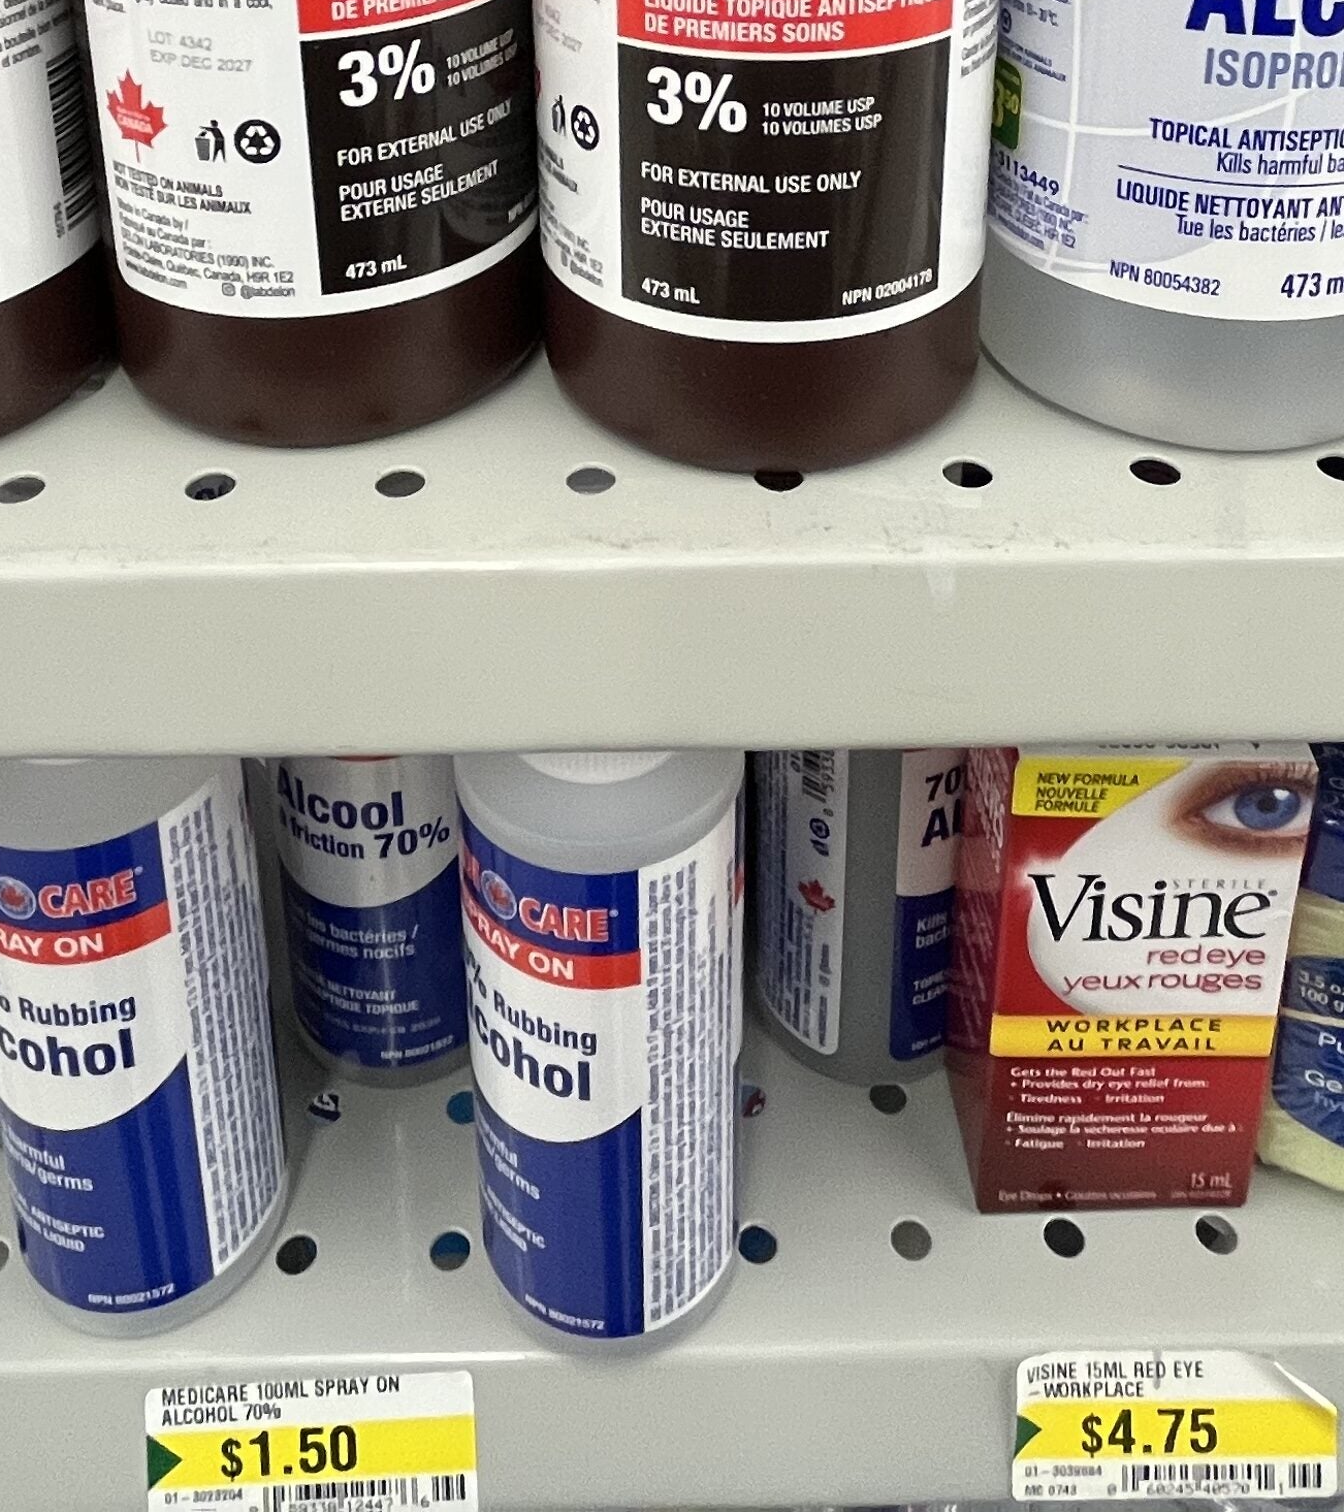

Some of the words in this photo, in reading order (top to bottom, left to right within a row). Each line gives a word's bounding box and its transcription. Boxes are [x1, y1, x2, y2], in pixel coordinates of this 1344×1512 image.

[644, 15, 667, 35] DE
[673, 19, 776, 43] PREMIERS
[782, 21, 845, 43] SOINS
[217, 57, 252, 72] 2027
[336, 40, 435, 108] 3%
[646, 66, 747, 134] 3%
[762, 103, 780, 118] 10
[783, 101, 843, 118] VOLUME
[847, 97, 875, 114] USP
[1149, 116, 1231, 150] TOPICAL
[641, 161, 673, 184] FOR
[679, 169, 770, 194] EXTERNAL
[776, 176, 810, 194] USE
[817, 170, 861, 191] ONLY
[1217, 152, 1252, 174] Kills
[1257, 150, 1324, 176] harmful
[1116, 178, 1190, 213] LIQUIDE
[1194, 192, 1312, 220] NETTOYANT
[1175, 213, 1206, 237] Tue
[1210, 221, 1234, 241] les
[1238, 218, 1316, 242] bactéries
[1109, 261, 1141, 284] NPN
[1144, 269, 1221, 297] 80054382
[1280, 273, 1321, 298] 473
[1036, 787, 1108, 801] NOUVELLE
[1037, 772, 1069, 786] NEW
[1074, 773, 1139, 785] FORMULA
[279, 765, 404, 830] Alcool
[1035, 800, 1101, 813] FORMULE
[375, 816, 450, 858] 70%
[38, 868, 137, 918] CARE
[1028, 874, 1274, 941] Visine
[519, 897, 610, 941] CARE
[53, 934, 104, 958] ON
[1148, 972, 1262, 992] rouges
[20, 996, 137, 1026] Rubbing
[494, 992, 597, 1057] Rubbing
[1047, 1018, 1222, 1033] WORKPLACE
[1048, 1038, 1085, 1050] AU
[1102, 1037, 1216, 1050] TRAVAIL
[1027, 1362, 1077, 1384] VISINE
[1087, 1362, 1127, 1378] 15ML
[1134, 1361, 1166, 1378] RED
[1174, 1360, 1204, 1378] EYE
[162, 1384, 248, 1406] MEDICARE
[258, 1381, 308, 1400] 100ML
[315, 1377, 368, 1396] SPRAY
[377, 1376, 400, 1392] ON
[162, 1406, 238, 1426] ALCOHOL
[245, 1403, 281, 1419] 70%
[1082, 1408, 1217, 1457] $4.75
[222, 1425, 357, 1481] $1.50
